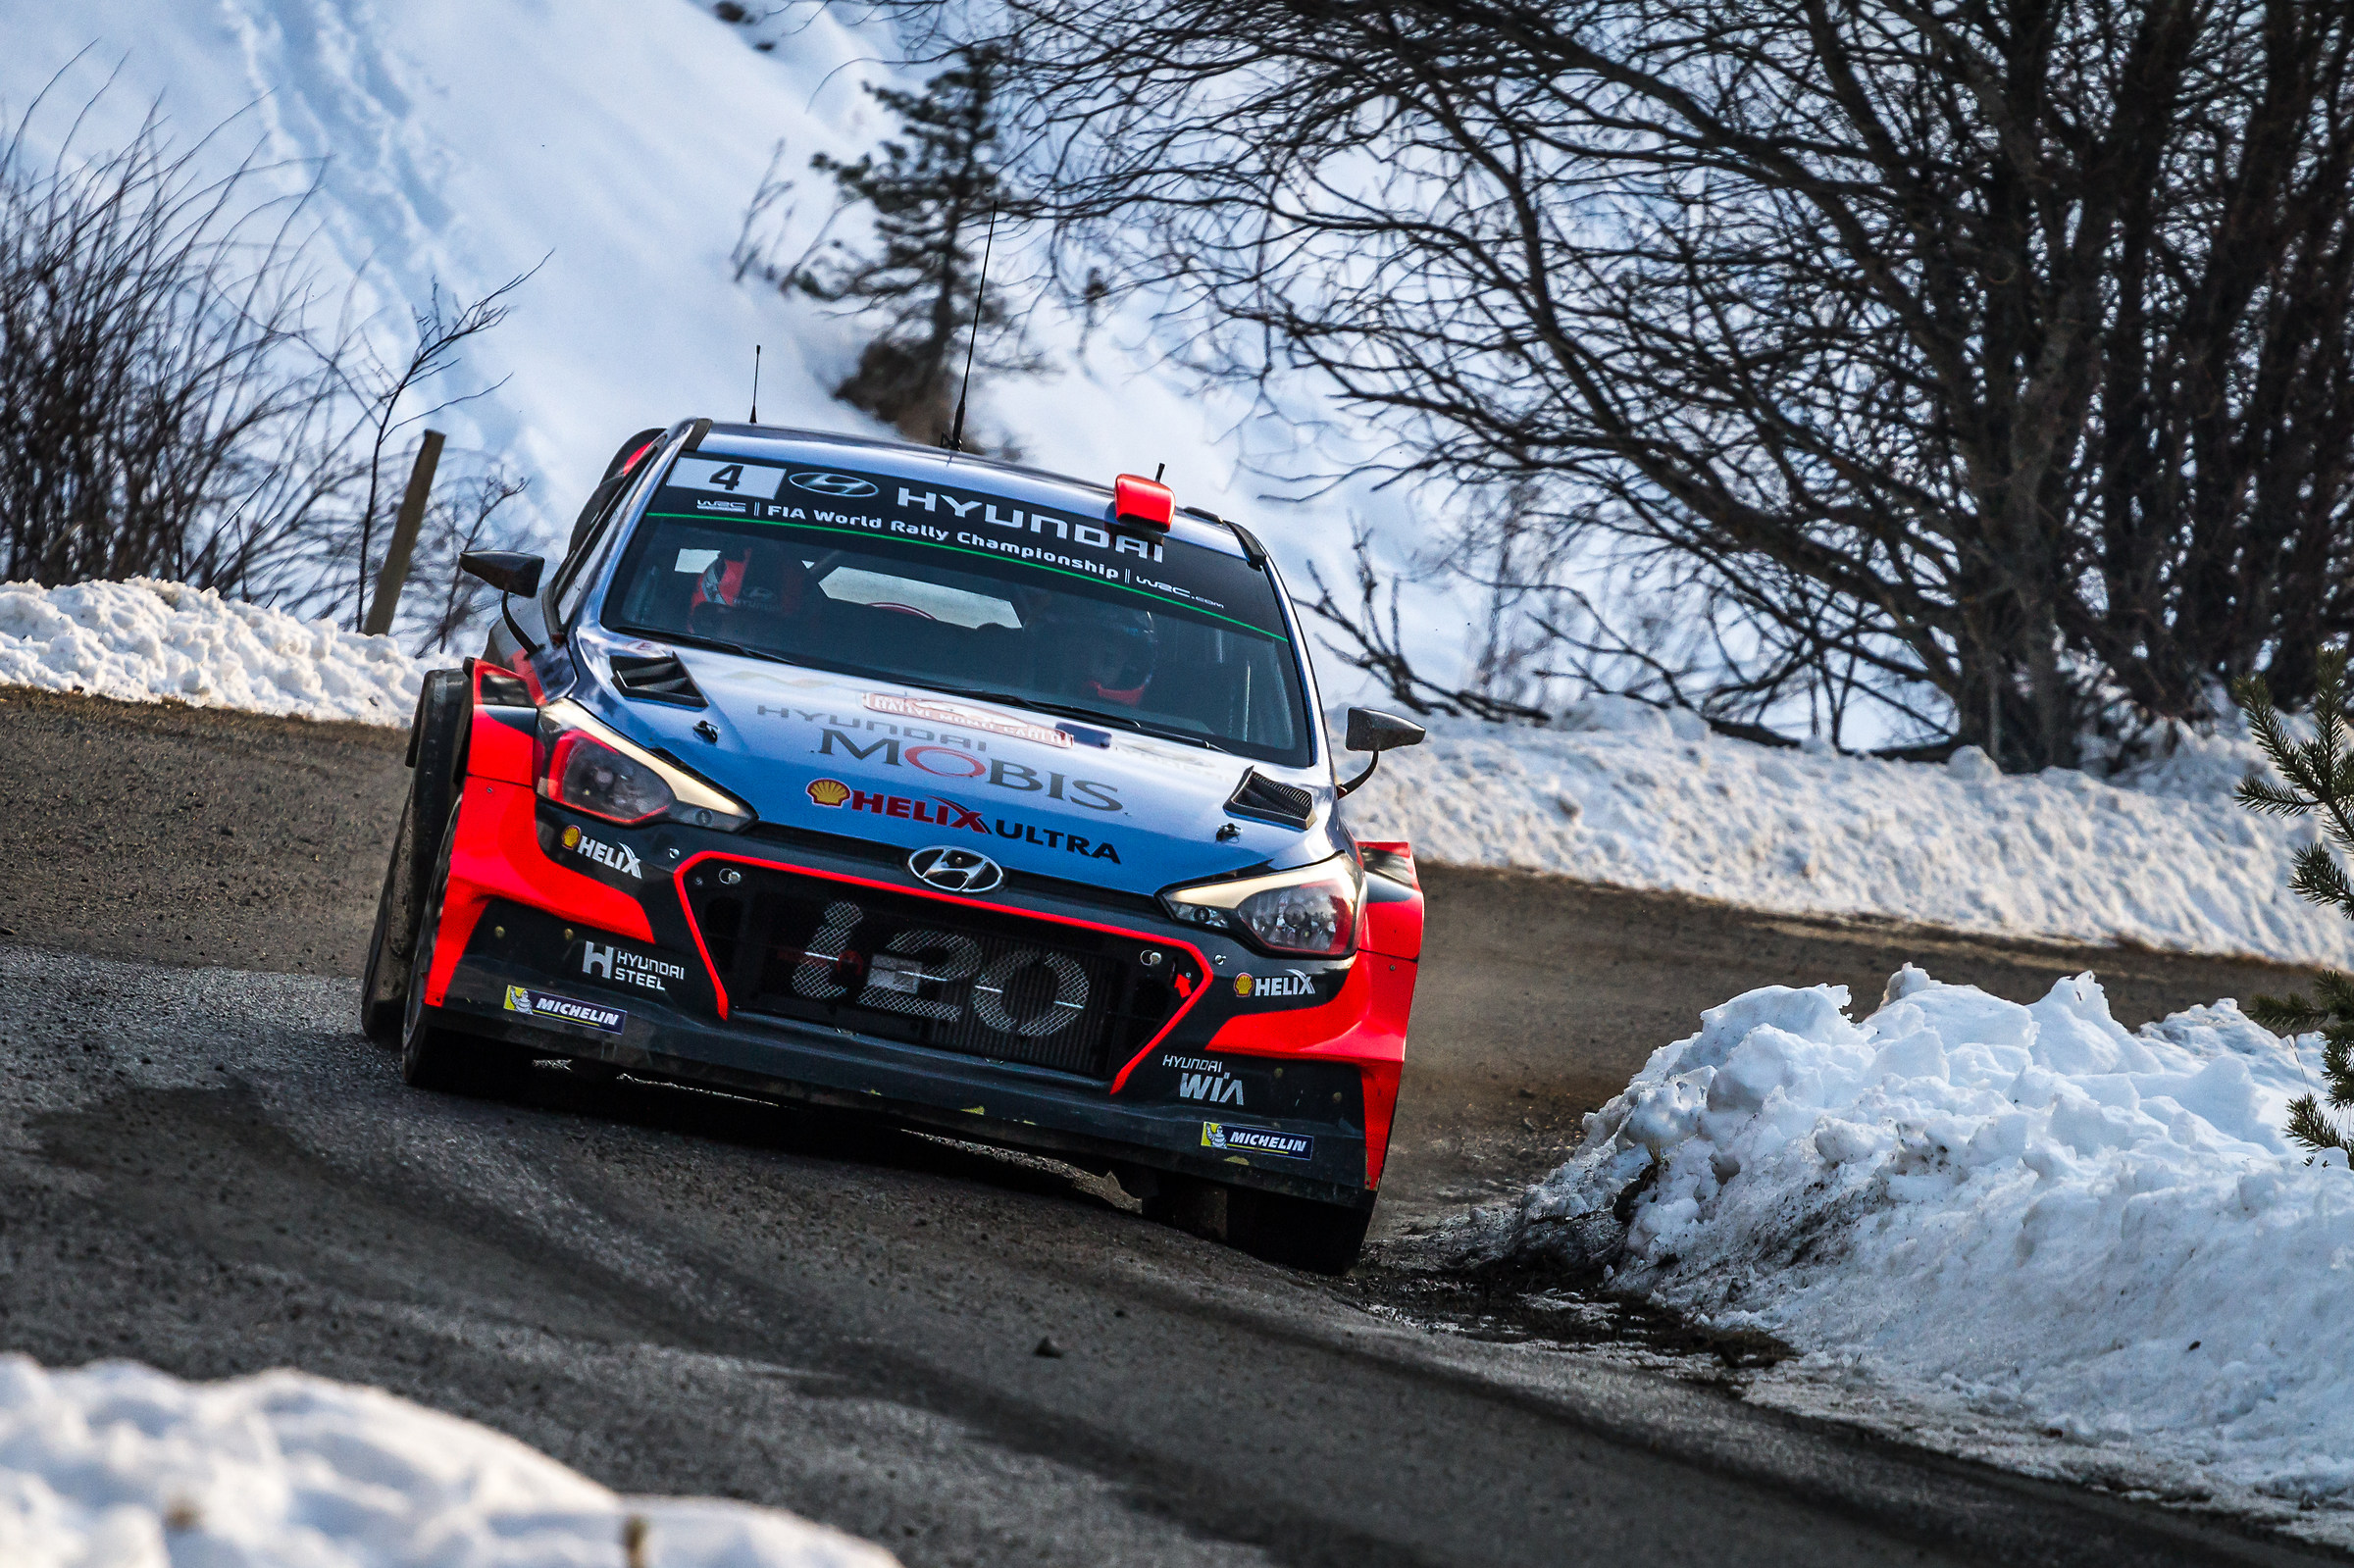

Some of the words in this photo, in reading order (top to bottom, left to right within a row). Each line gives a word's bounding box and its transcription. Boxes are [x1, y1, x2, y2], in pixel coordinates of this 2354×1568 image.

[709, 464, 744, 491] 4
[896, 486, 1163, 563] HYUNDAI
[767, 505, 806, 521] FIA
[813, 509, 882, 530] World
[890, 520, 948, 541] Rally
[956, 531, 1119, 581] Championship
[756, 704, 987, 752] HYUNDAI
[818, 728, 1124, 812] MOBIS
[849, 789, 992, 835] HELIX
[995, 819, 1122, 865] ULTRA
[577, 835, 642, 880] HELIX
[614, 967, 666, 991] STEEL
[617, 950, 685, 981] HYUNDAI
[1254, 965, 1316, 996] HELIX
[536, 997, 619, 1026] MICHELIN
[1162, 1054, 1223, 1073] HYUNDAI
[1229, 1131, 1307, 1152] MICHELIN
